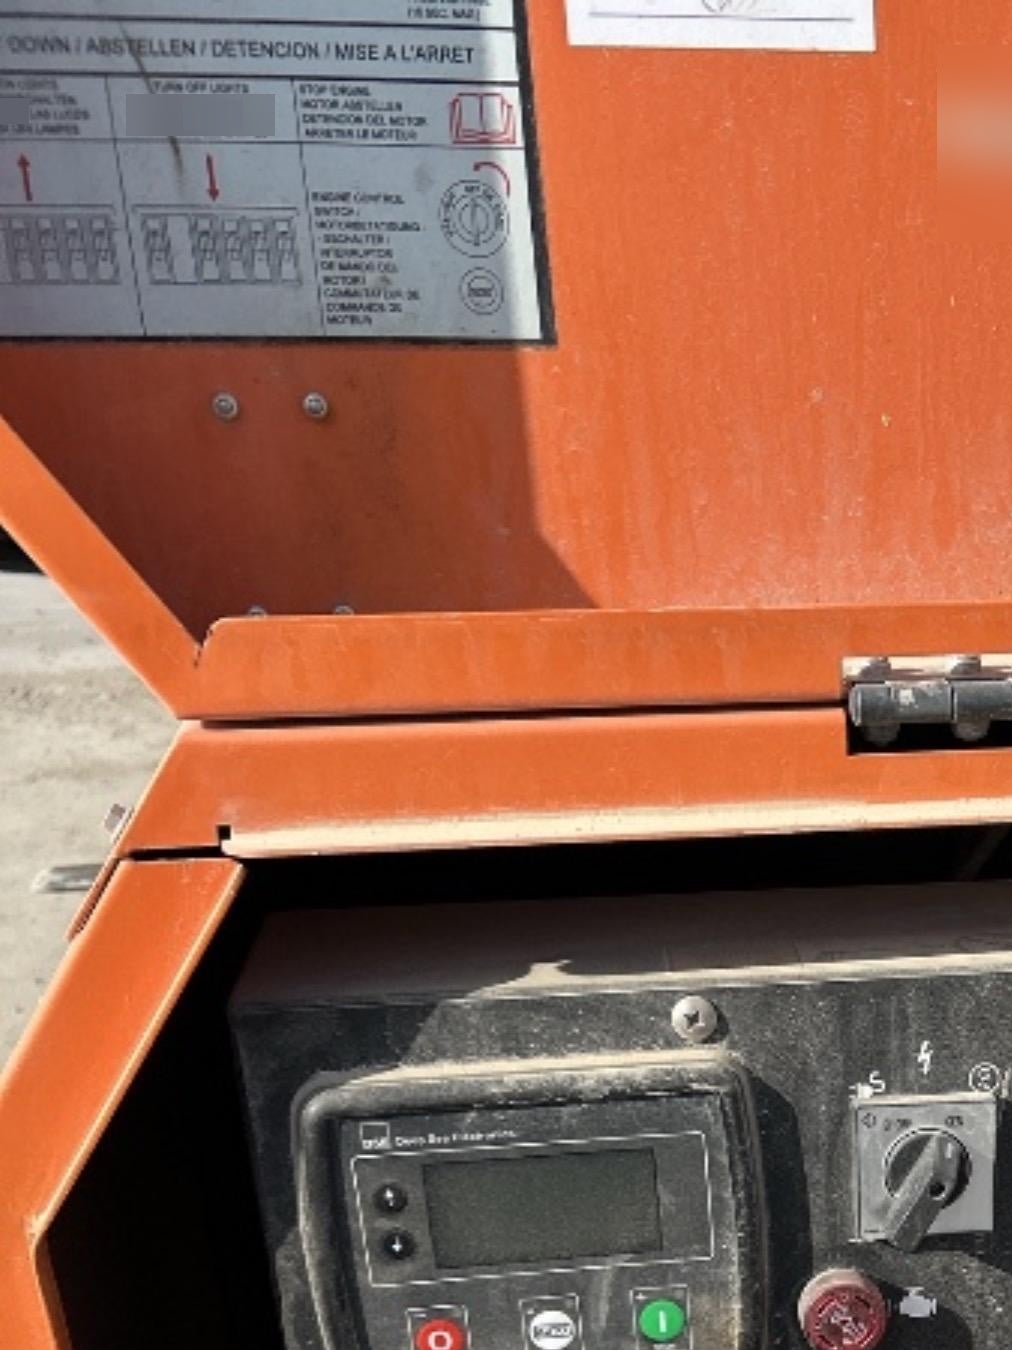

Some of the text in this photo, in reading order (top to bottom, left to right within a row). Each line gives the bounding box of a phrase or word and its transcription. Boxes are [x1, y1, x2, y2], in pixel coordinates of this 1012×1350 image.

[7, 36, 70, 54] DOWN
[86, 37, 196, 57] ABSTELLEN
[335, 43, 379, 61] MISE
[383, 44, 397, 62] A
[401, 44, 475, 64] L'ARRET
